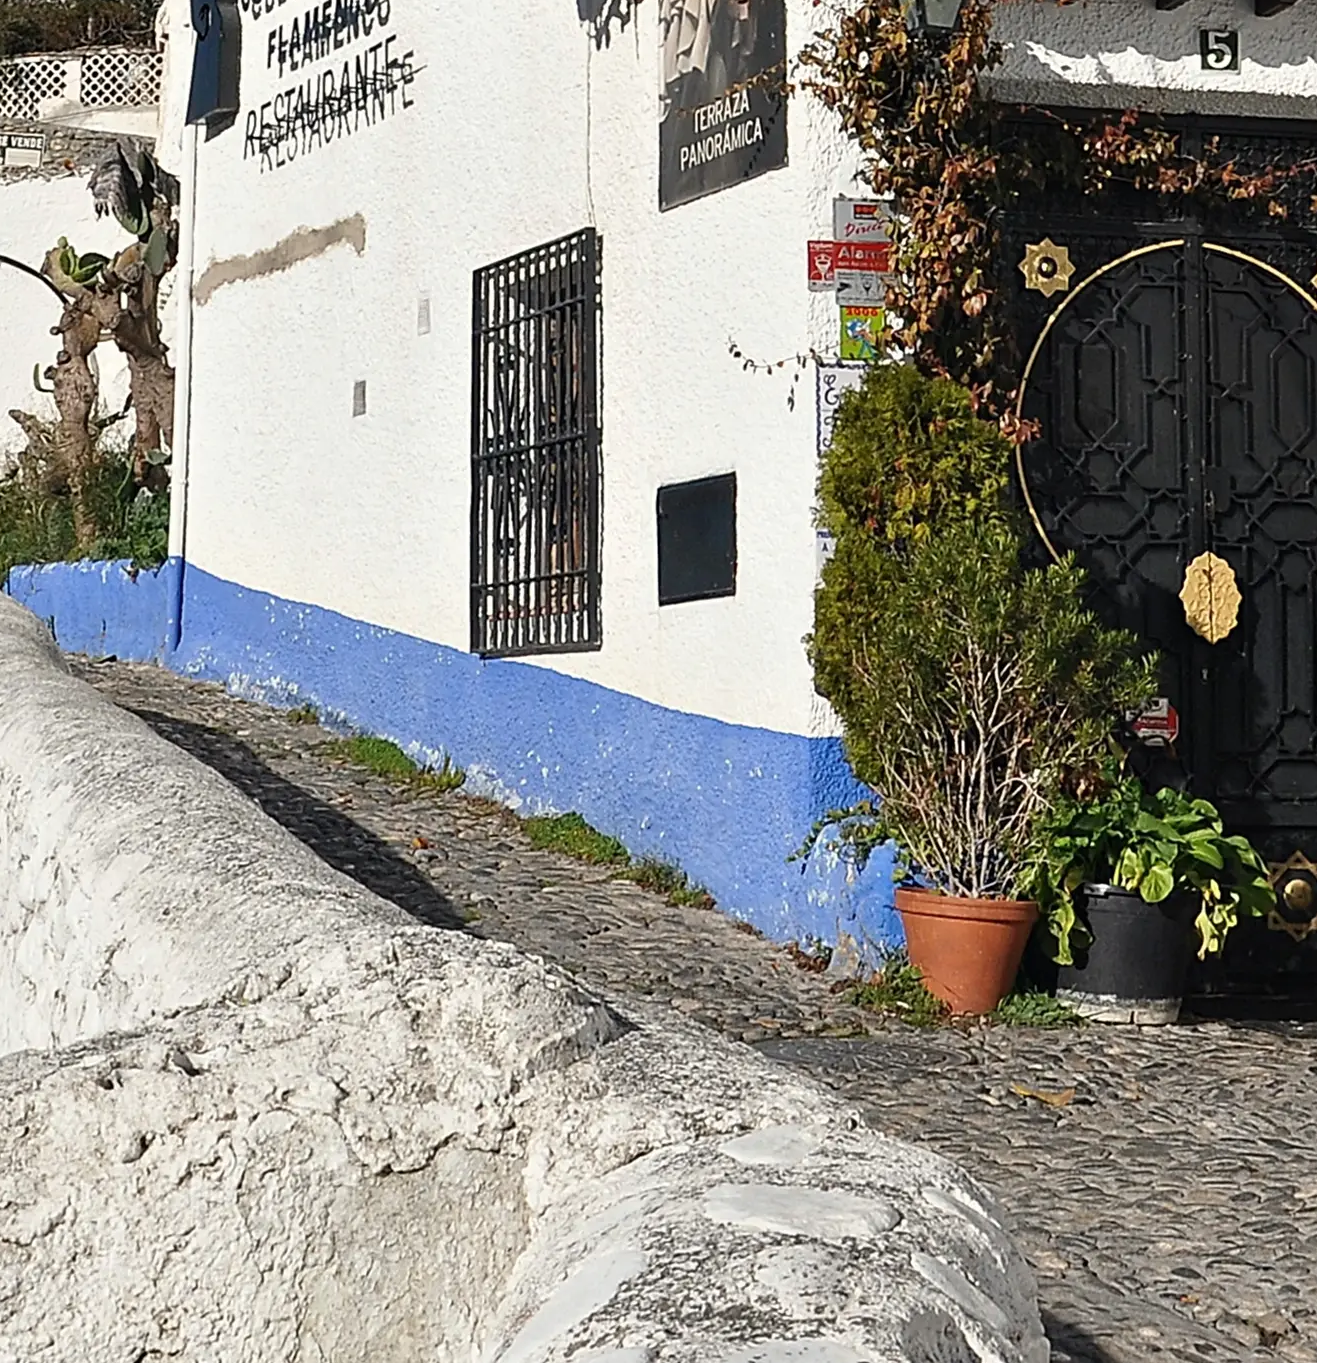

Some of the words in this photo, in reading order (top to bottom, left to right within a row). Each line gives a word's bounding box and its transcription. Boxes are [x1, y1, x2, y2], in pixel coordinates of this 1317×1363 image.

[1206, 31, 1233, 69] 5
[243, 34, 399, 161] RESTAURANTE
[693, 88, 751, 134] TERRAZA
[10, 135, 43, 149] VENDE
[680, 116, 764, 172] PANORÁMICA
